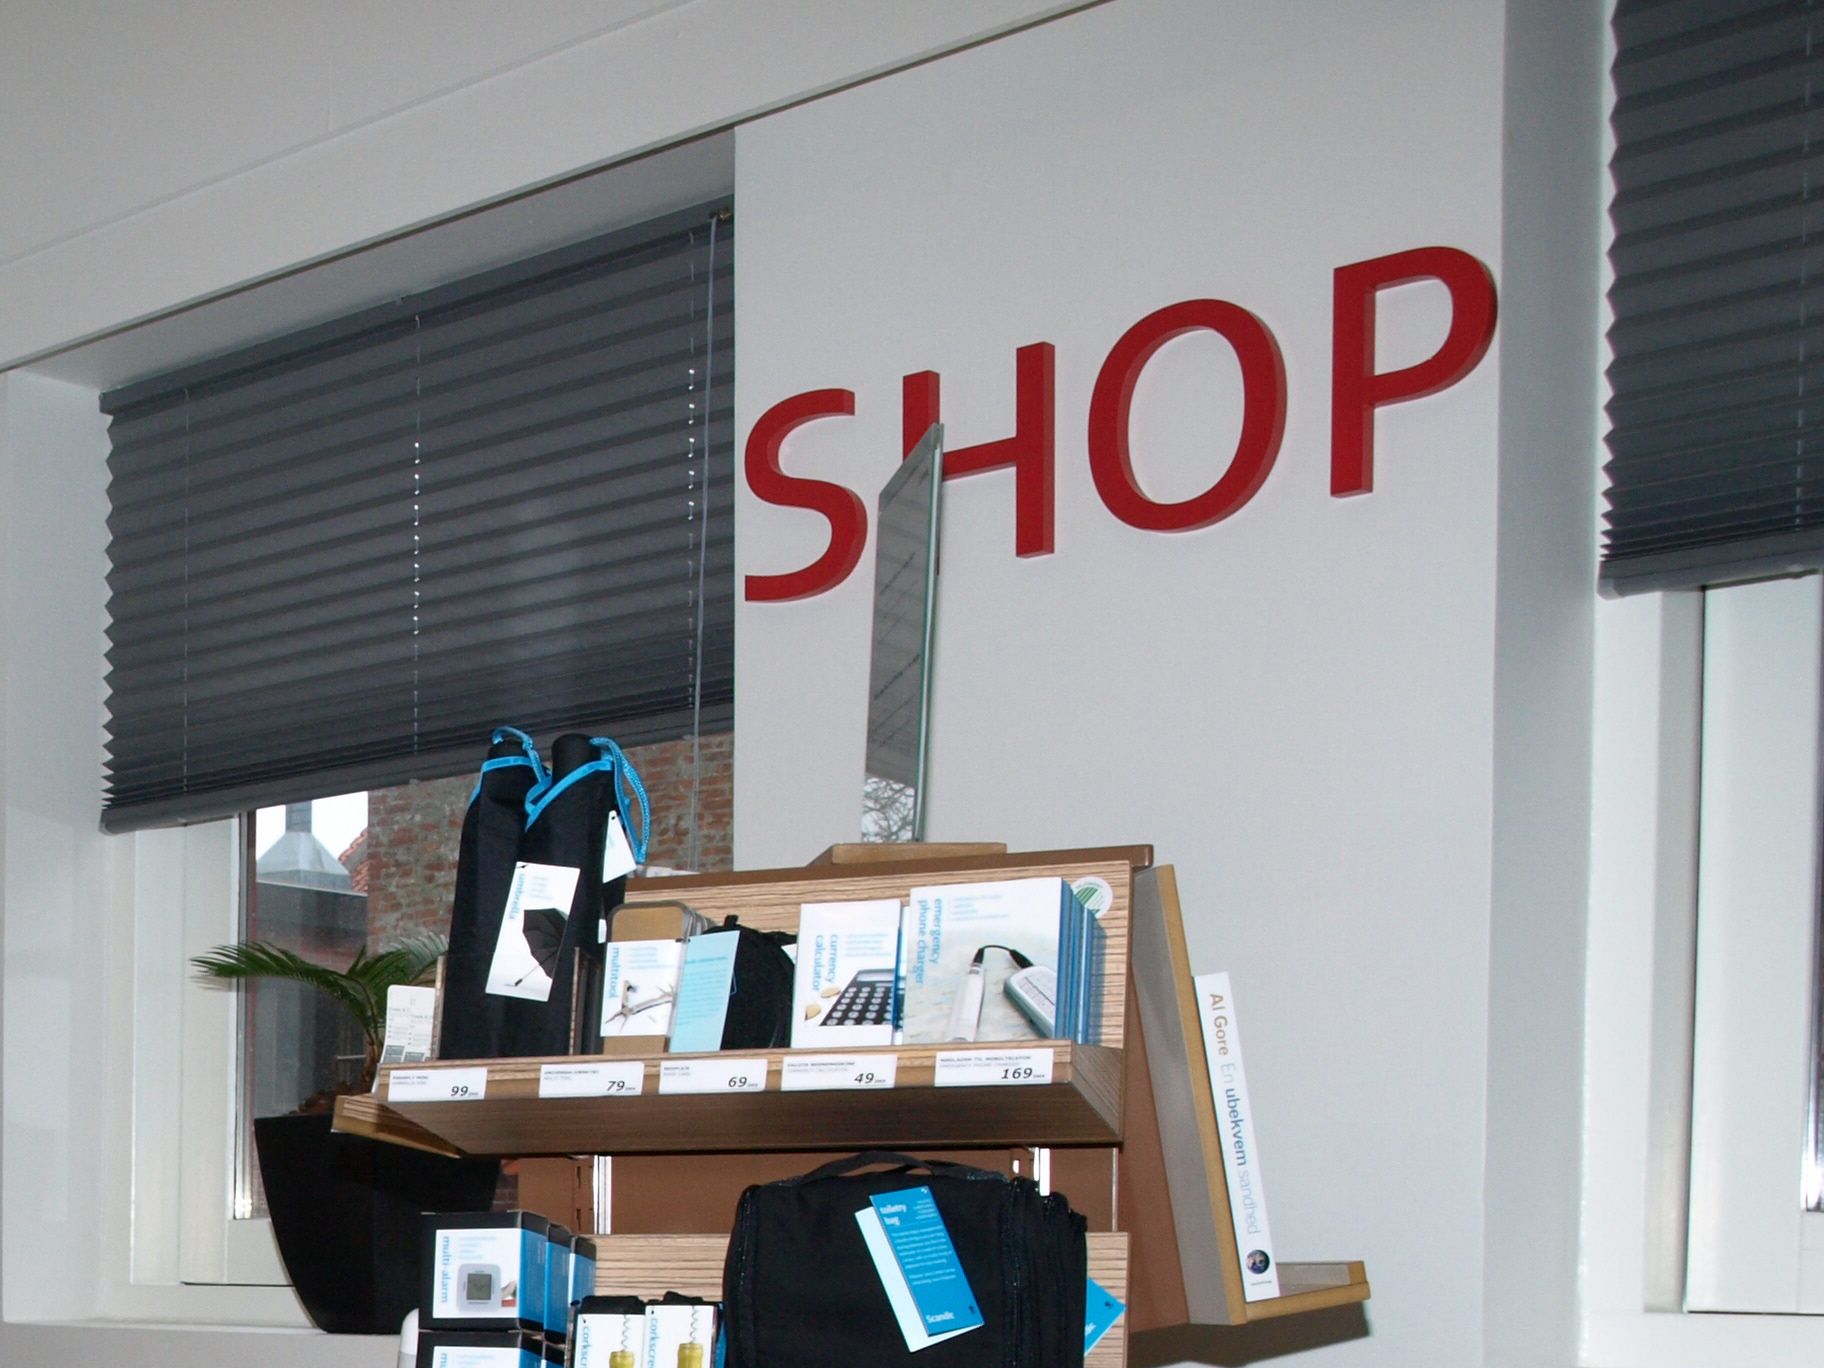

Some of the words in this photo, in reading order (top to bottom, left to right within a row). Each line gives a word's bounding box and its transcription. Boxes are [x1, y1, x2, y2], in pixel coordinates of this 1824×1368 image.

[744, 246, 1499, 603] SHOP
[917, 900, 928, 936] phone
[929, 898, 943, 965] emergency
[608, 947, 619, 999] multitool
[812, 934, 824, 992] calculator
[825, 934, 839, 984] currency
[913, 940, 928, 985] charger
[1209, 992, 1225, 1012] Al
[1212, 1015, 1229, 1056] Gore
[450, 1085, 469, 1097] 99
[606, 1080, 625, 1092] 79
[728, 1076, 748, 1088] 69
[854, 1072, 875, 1084] 49
[1001, 1067, 1033, 1079] 169
[1225, 1087, 1247, 1167] ubekvem
[1238, 1171, 1262, 1235] sandhed
[926, 1311, 955, 1324] Scandic
